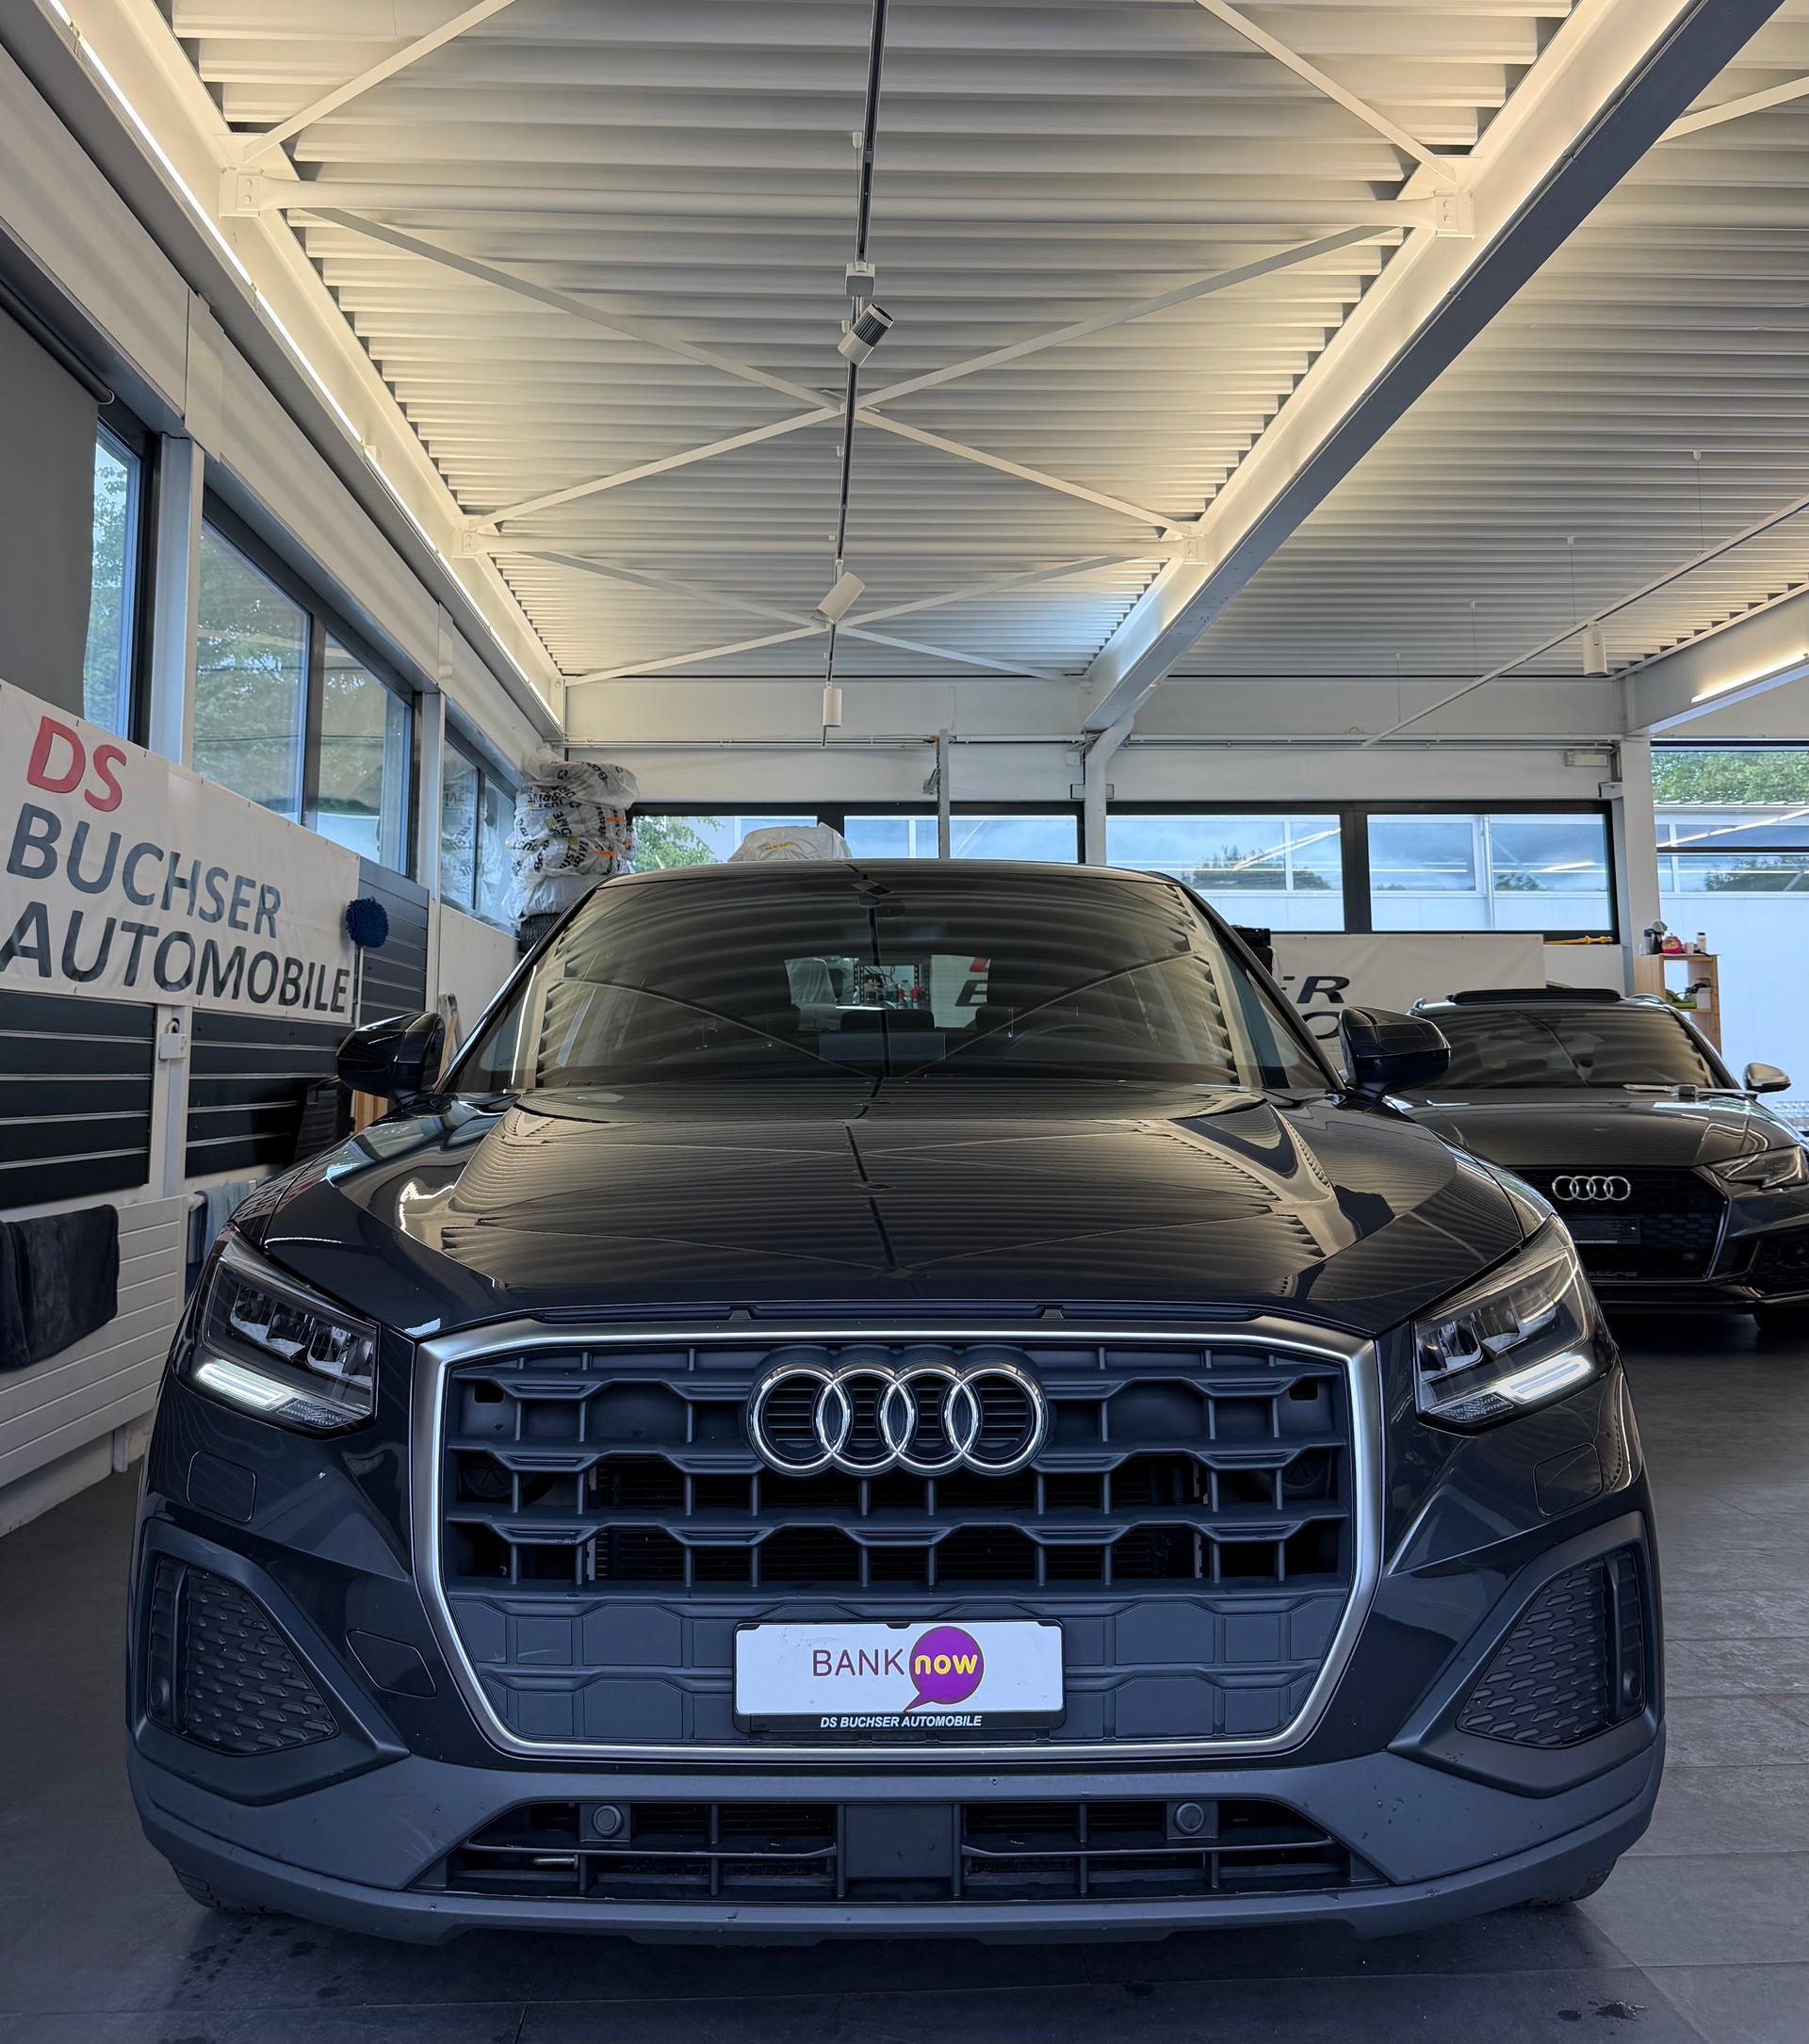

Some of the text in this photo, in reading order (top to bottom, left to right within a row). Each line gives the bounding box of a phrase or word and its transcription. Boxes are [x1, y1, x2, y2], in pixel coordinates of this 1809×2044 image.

[27, 715, 127, 812] DS
[7, 803, 282, 939] BUCHSER
[0, 900, 350, 1014] AUTOMOBILE
[812, 1648, 979, 1677] BANK now
[820, 1715, 983, 1728] DS BUCHSER AUTOMOBILE
